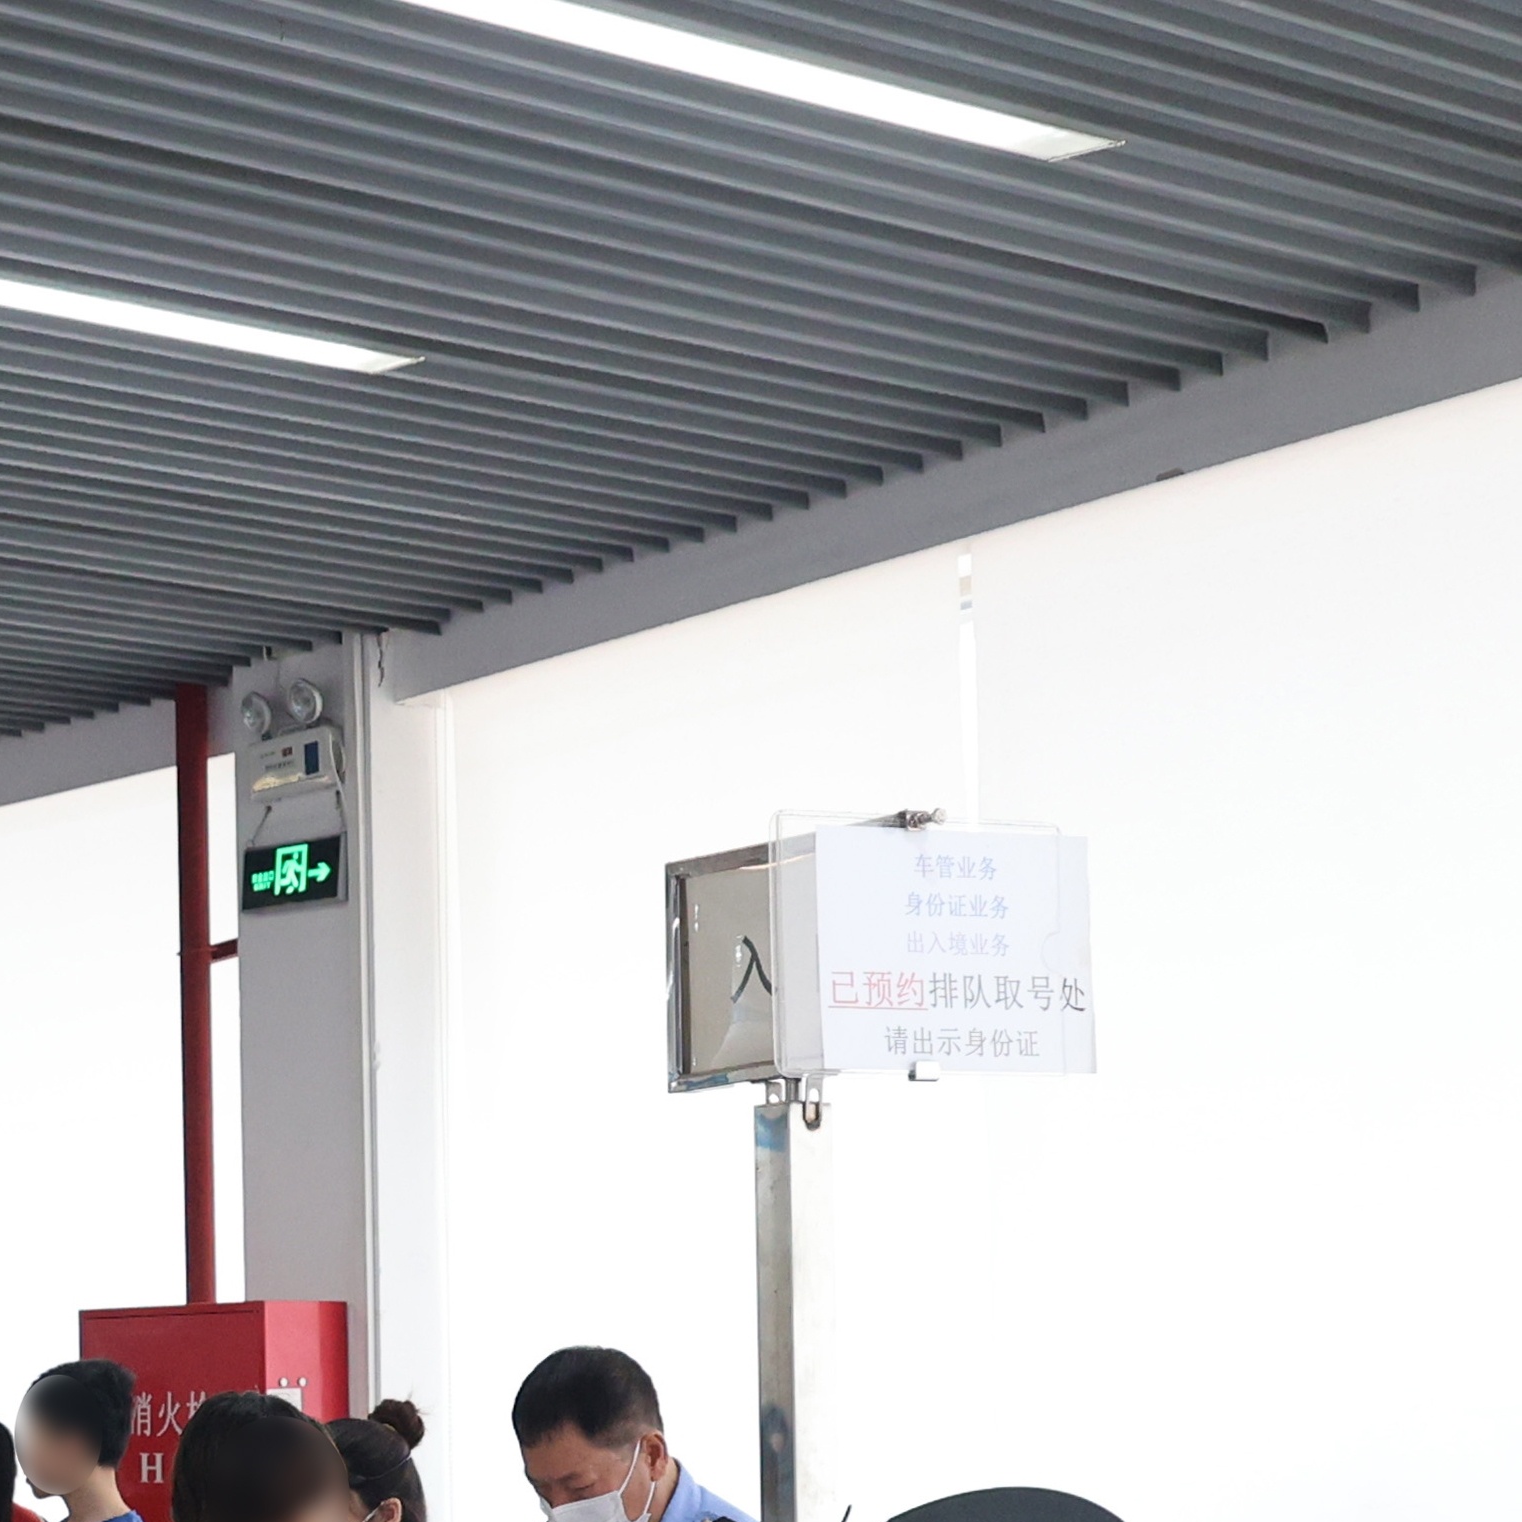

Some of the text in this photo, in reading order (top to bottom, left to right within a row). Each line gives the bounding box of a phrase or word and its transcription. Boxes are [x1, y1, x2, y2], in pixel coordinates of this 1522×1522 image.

[913, 853, 997, 881] 车管业务
[904, 892, 1009, 919] 身份证业务
[905, 931, 1010, 957] 出入境业务
[829, 970, 1087, 1013] 已预约排队取号处
[883, 1026, 1041, 1058] 请出示身份证
